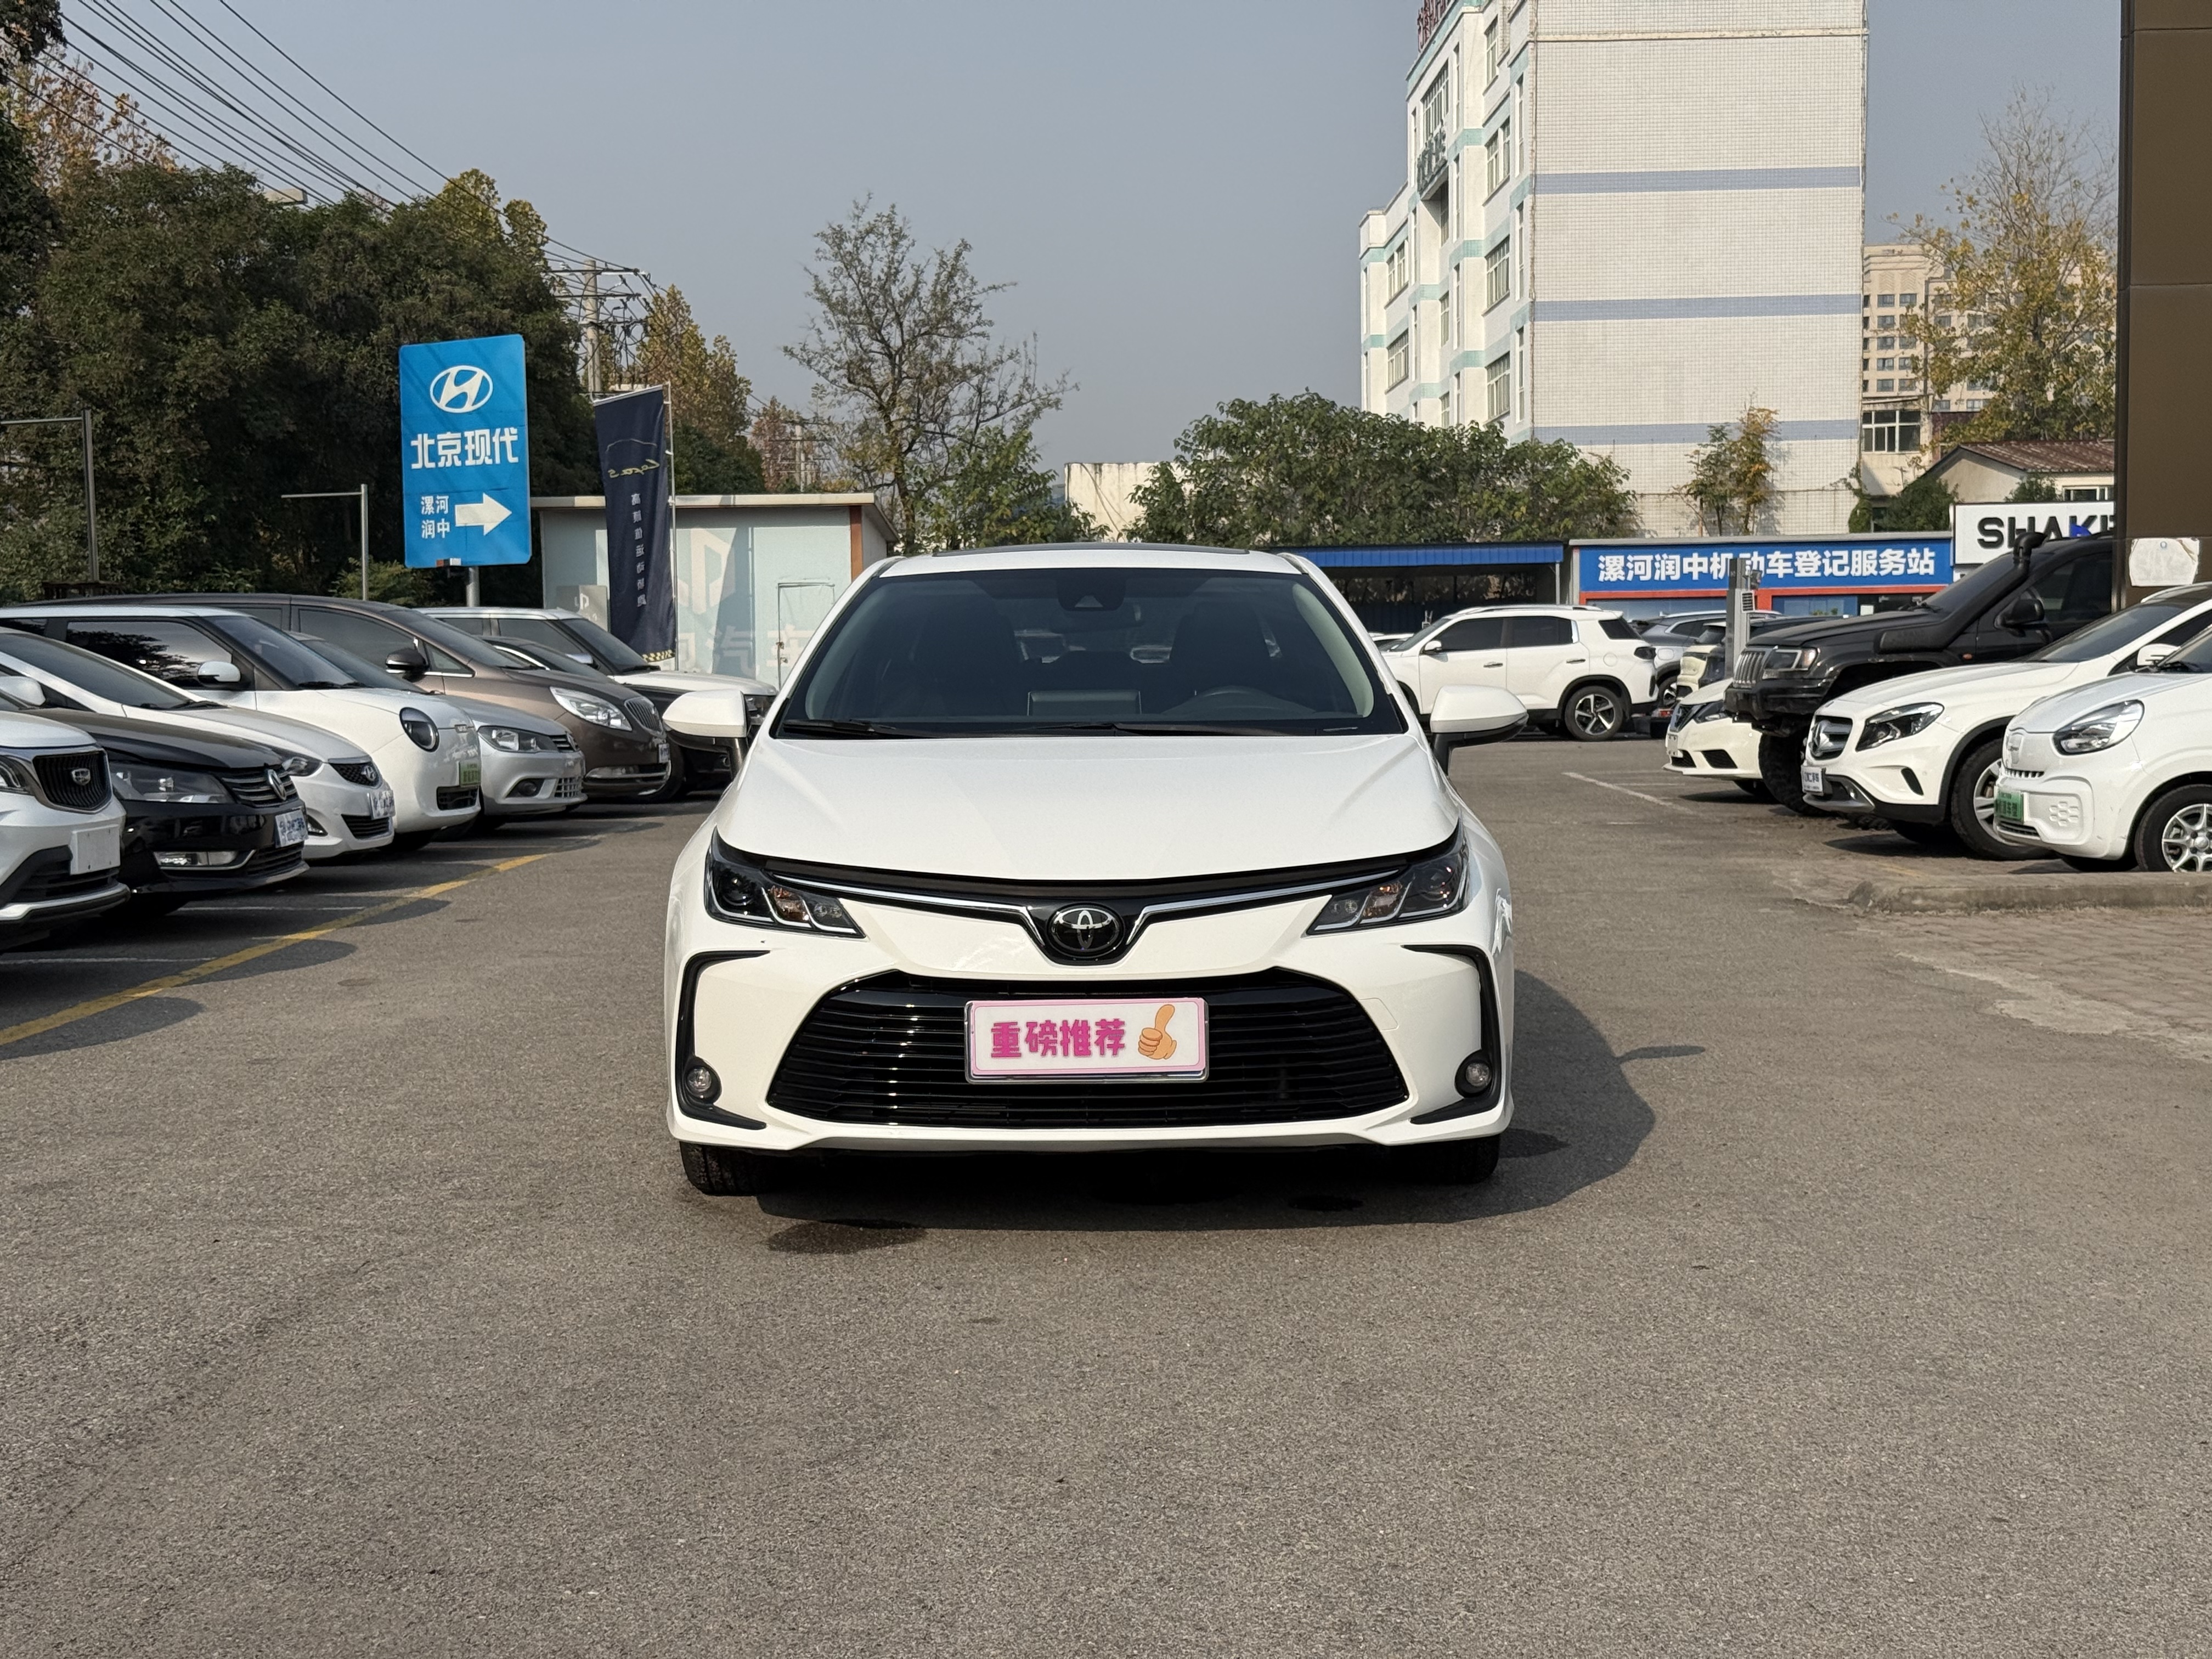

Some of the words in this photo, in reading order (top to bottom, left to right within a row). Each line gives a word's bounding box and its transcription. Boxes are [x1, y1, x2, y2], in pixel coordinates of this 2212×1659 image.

[410, 427, 519, 469] 北京现代
[421, 495, 449, 516] 漯河
[421, 519, 451, 539] 润中
[1598, 547, 1936, 582] 漯河润中机动车登记服务站
[991, 1018, 1125, 1058] 重磅推荐
